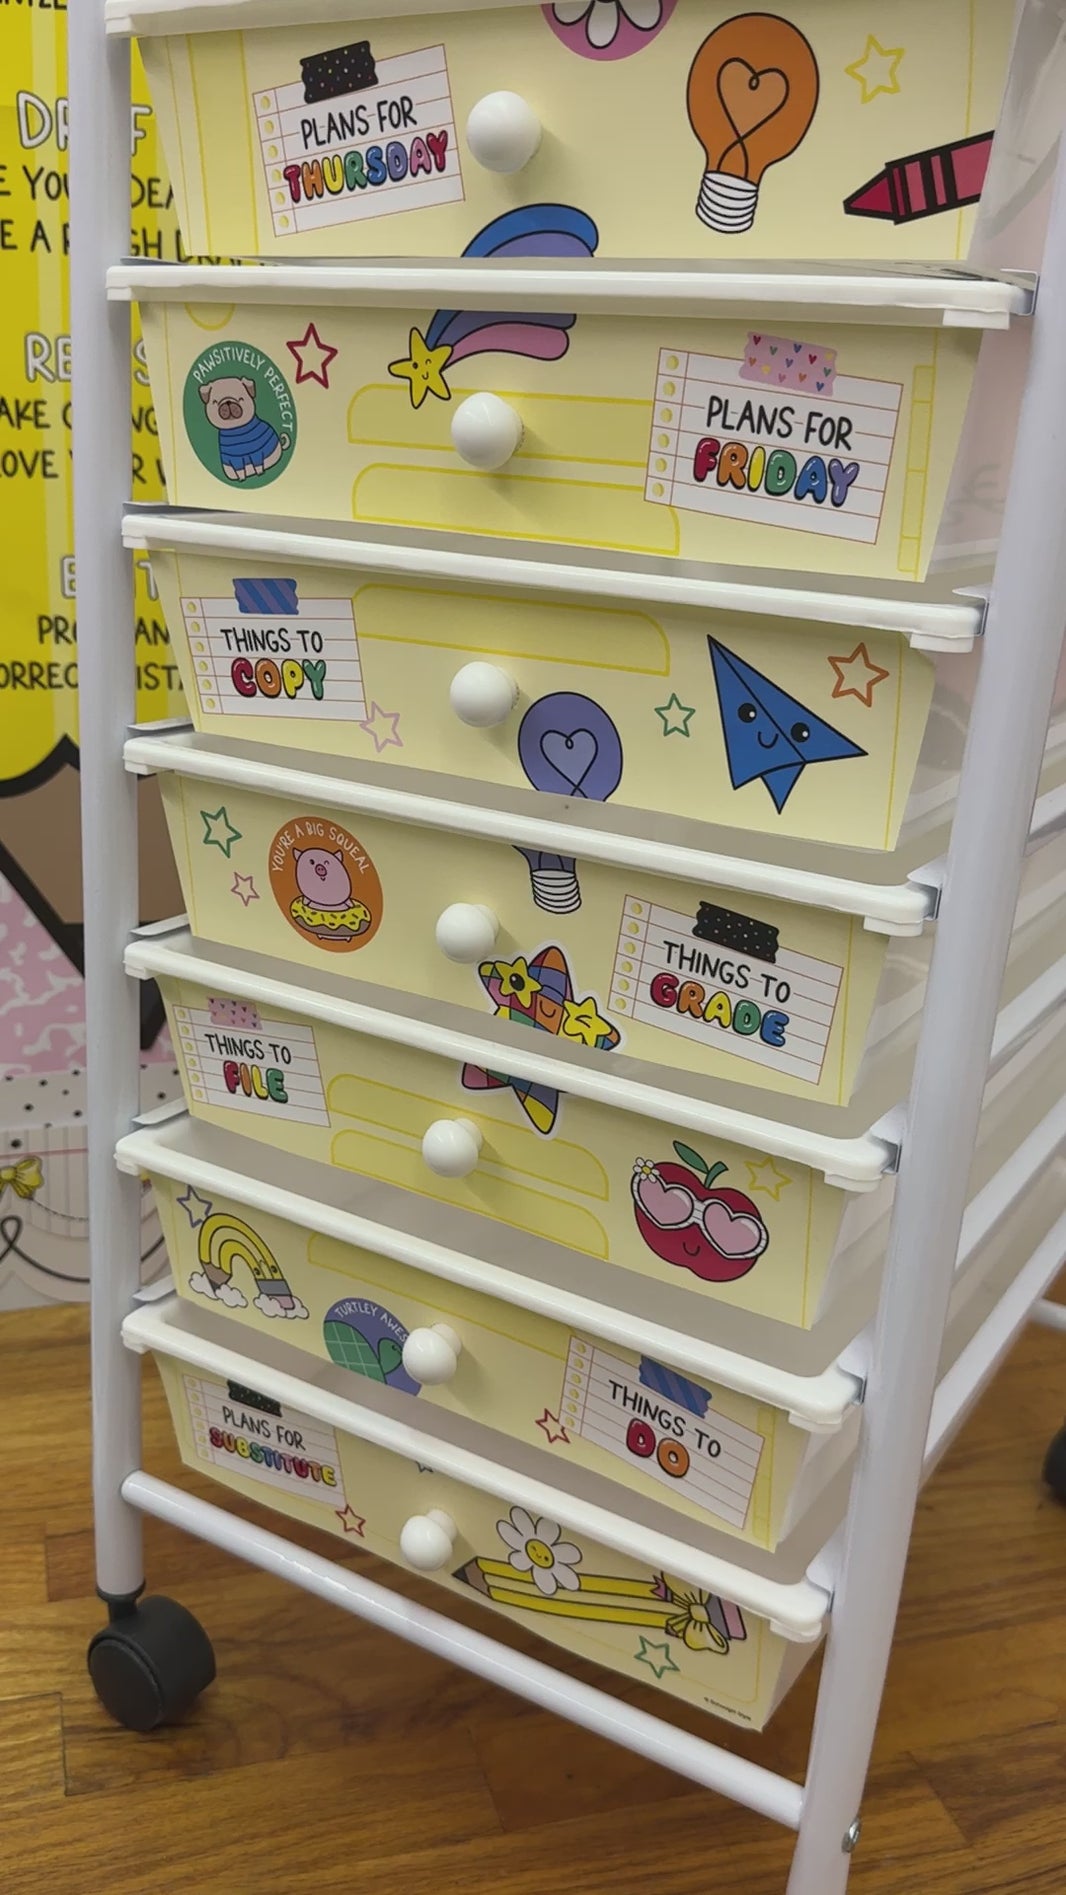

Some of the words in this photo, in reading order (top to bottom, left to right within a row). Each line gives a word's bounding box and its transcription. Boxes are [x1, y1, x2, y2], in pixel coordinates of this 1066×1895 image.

[301, 105, 370, 150] PLANS
[377, 96, 417, 132] FOR
[284, 130, 448, 203] THURSDAY
[0, 396, 50, 430] AKE
[192, 347, 266, 383] PAWSITIVELY
[264, 367, 294, 432] PERFECT
[706, 395, 796, 438] PLANS
[804, 411, 853, 451] FOR
[693, 437, 860, 508] FRIDAY
[220, 627, 291, 653] THINGS
[296, 630, 323, 653] TO
[231, 657, 326, 700] COPY
[271, 830, 295, 873] YOU'RE
[295, 824, 305, 838] A
[305, 821, 324, 837] BIG
[329, 826, 370, 875] SQUEAL
[663, 940, 751, 989] THINGS
[761, 974, 791, 1003] TO
[650, 972, 790, 1048] GRADE
[204, 1033, 265, 1060] THINGS
[269, 1043, 292, 1065] TO
[223, 1060, 289, 1104] FILE
[334, 1301, 379, 1318] TURTLEY
[380, 1313, 409, 1343] AWES
[222, 1405, 271, 1438] PLANS
[276, 1425, 306, 1451] FOR
[608, 1379, 687, 1437] THINGS
[694, 1428, 721, 1458] TO
[209, 1426, 337, 1488] SUBSTITUTE
[626, 1417, 690, 1479] DO
